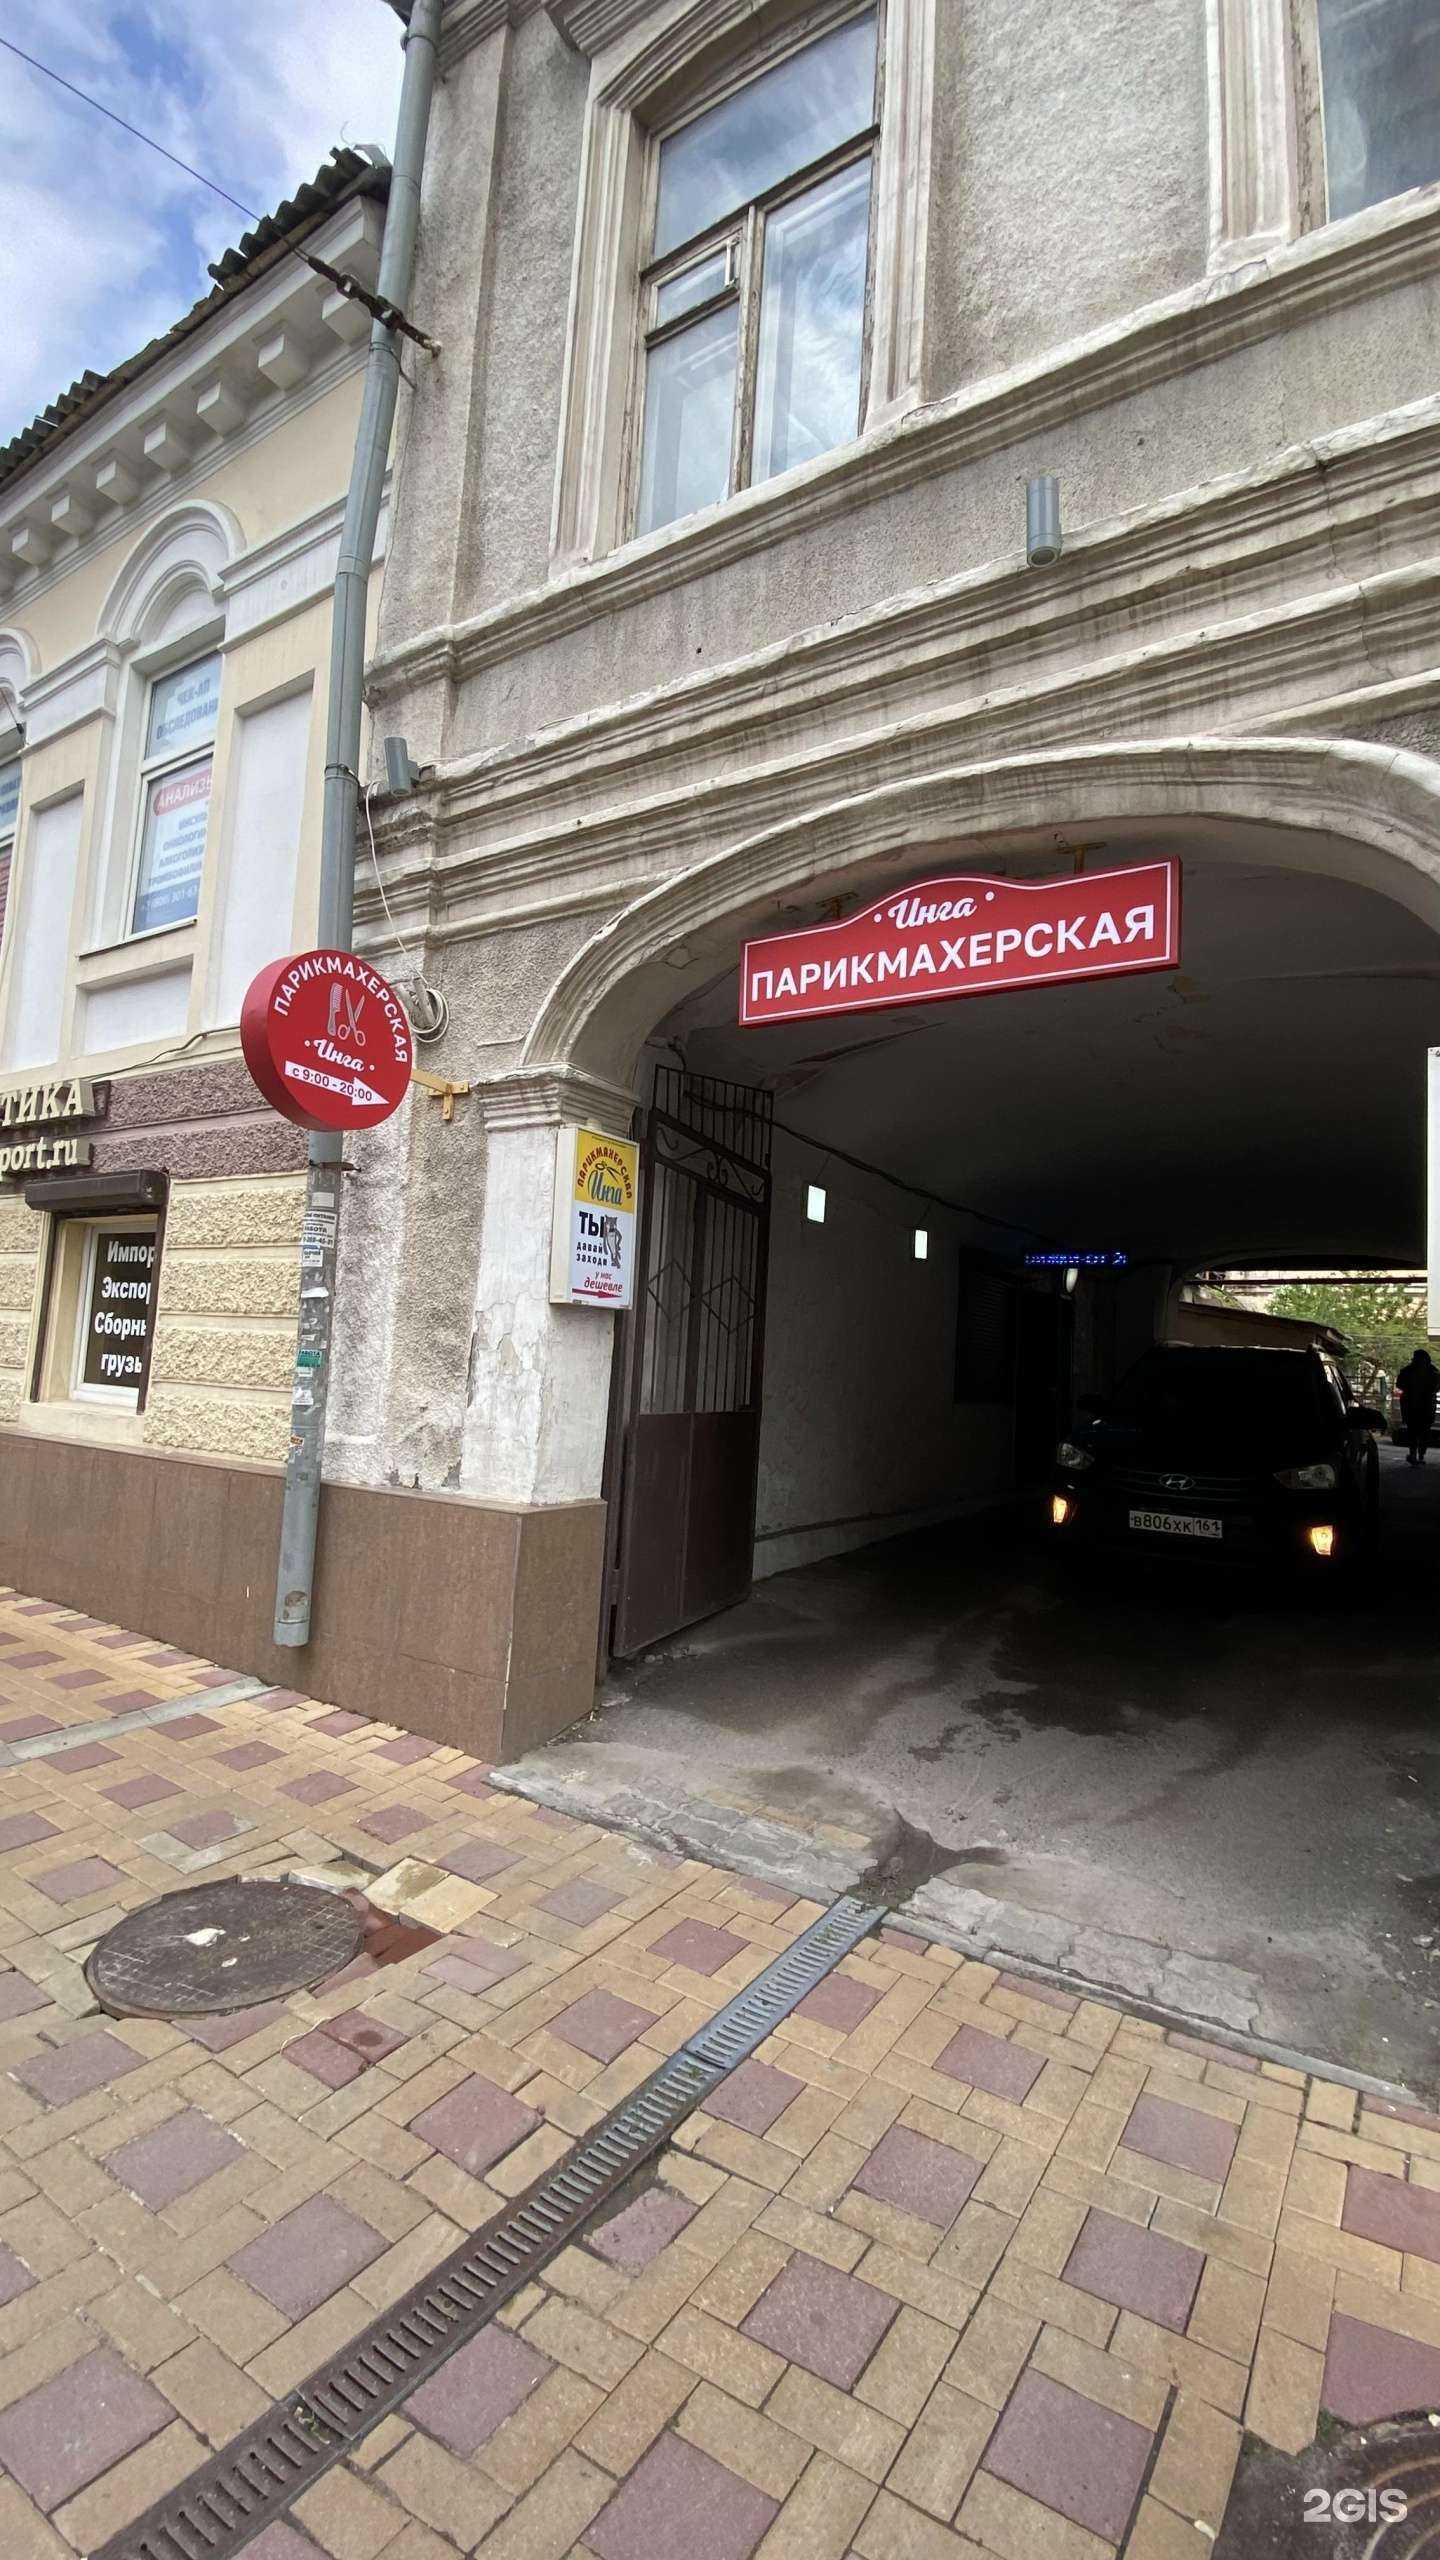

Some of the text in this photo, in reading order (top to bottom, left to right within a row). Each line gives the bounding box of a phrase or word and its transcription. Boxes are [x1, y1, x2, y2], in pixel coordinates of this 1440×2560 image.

[887, 895, 978, 929] Инга
[750, 904, 1155, 1002] ПАРИКМАХЕРСКАЯ
[273, 956, 408, 1063] ПАРИКМАХЕРСКАЯ
[313, 1038, 365, 1072] Инга
[577, 1146, 632, 1199] ПАРИКМАХЕРСКАЯ
[588, 1170, 623, 1205] Инга
[579, 1210, 605, 1238] ТЫ
[584, 1277, 623, 1293] дешевле
